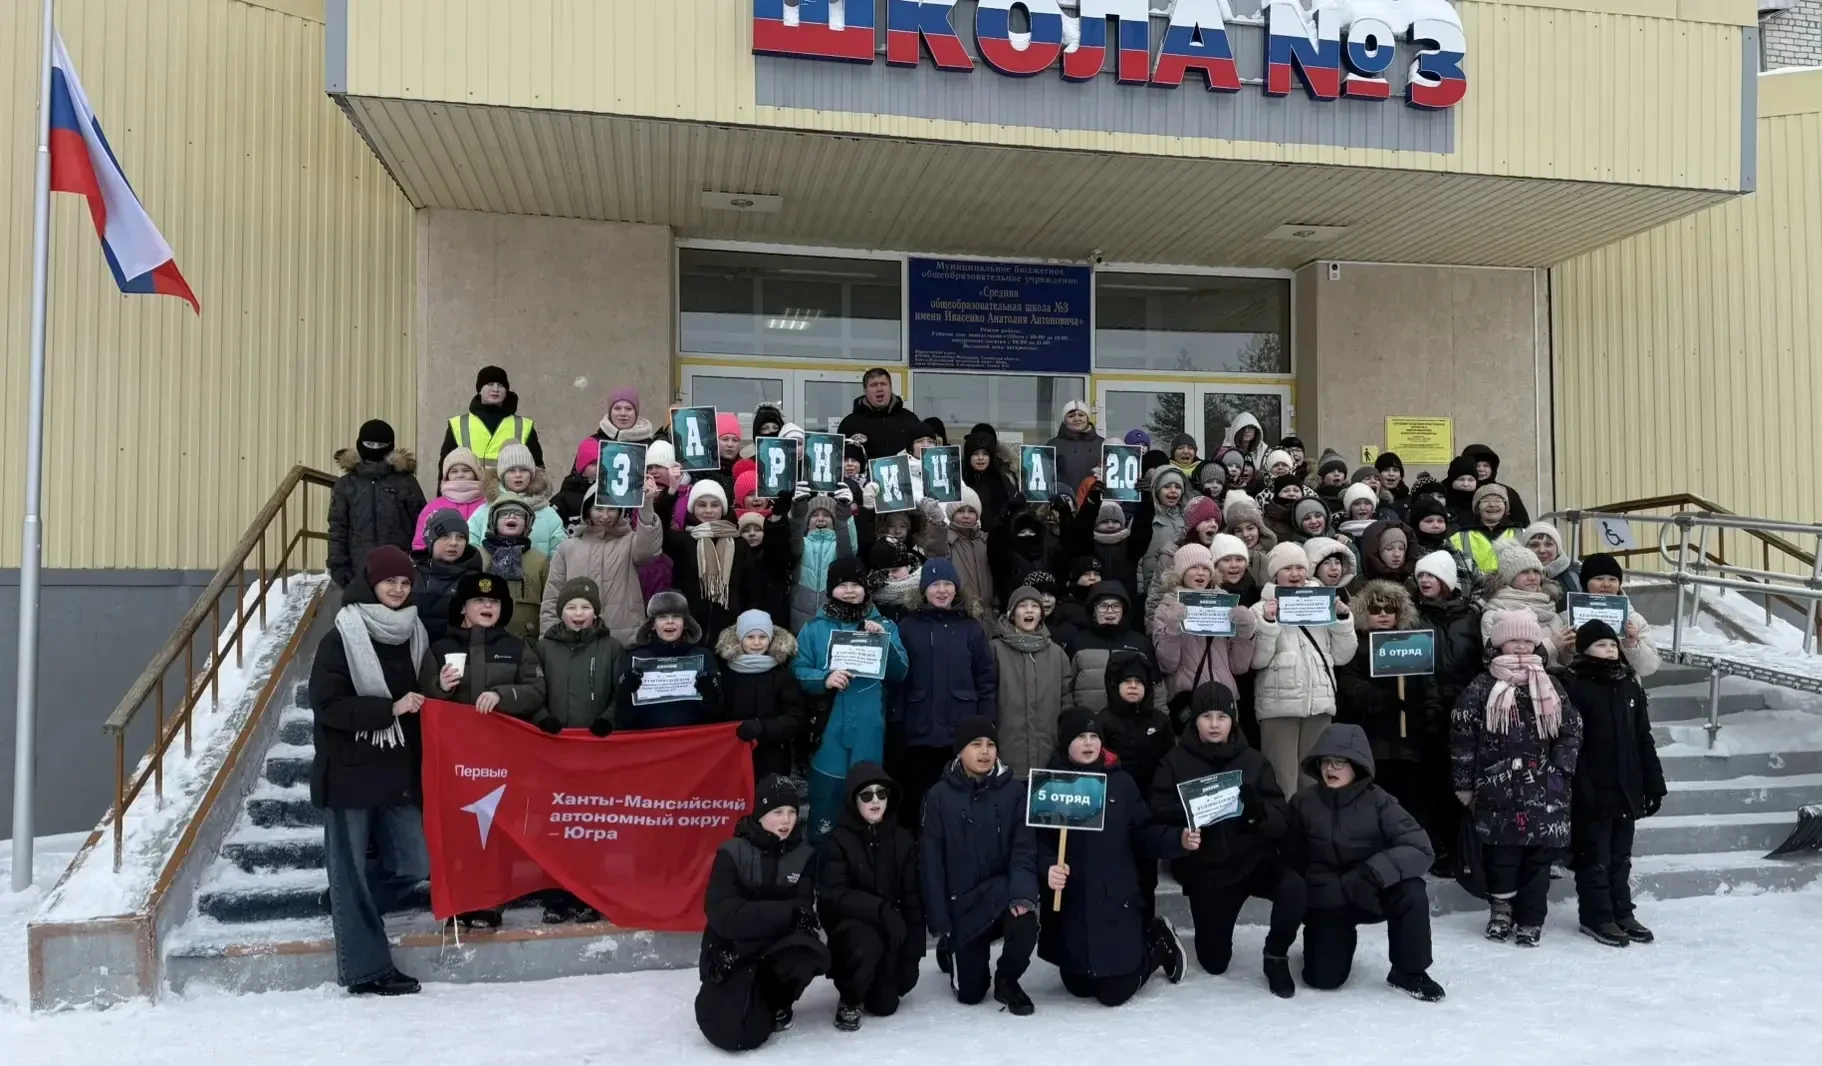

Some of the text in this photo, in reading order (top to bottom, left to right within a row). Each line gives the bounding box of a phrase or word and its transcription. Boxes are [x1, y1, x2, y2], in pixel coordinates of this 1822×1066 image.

[752, 0, 1468, 111] ШКОЛА №3
[936, 261, 1065, 276] Муниципальное бюджетное
[921, 270, 1079, 286] общеобразовательное учреждение
[930, 298, 1069, 314] общеобразовательная школа №3
[915, 311, 942, 322] имени
[944, 310, 985, 323] Ивасенко
[988, 313, 1028, 325] Анатолия
[1106, 453, 1138, 489] 2.0
[1379, 647, 1422, 657] 8 отряд
[454, 764, 508, 781] Первые
[551, 791, 746, 811] Ханты-Мансийский
[1038, 790, 1091, 807] 5 отряд
[549, 811, 730, 828] автономный округ
[564, 826, 618, 842] Югра
